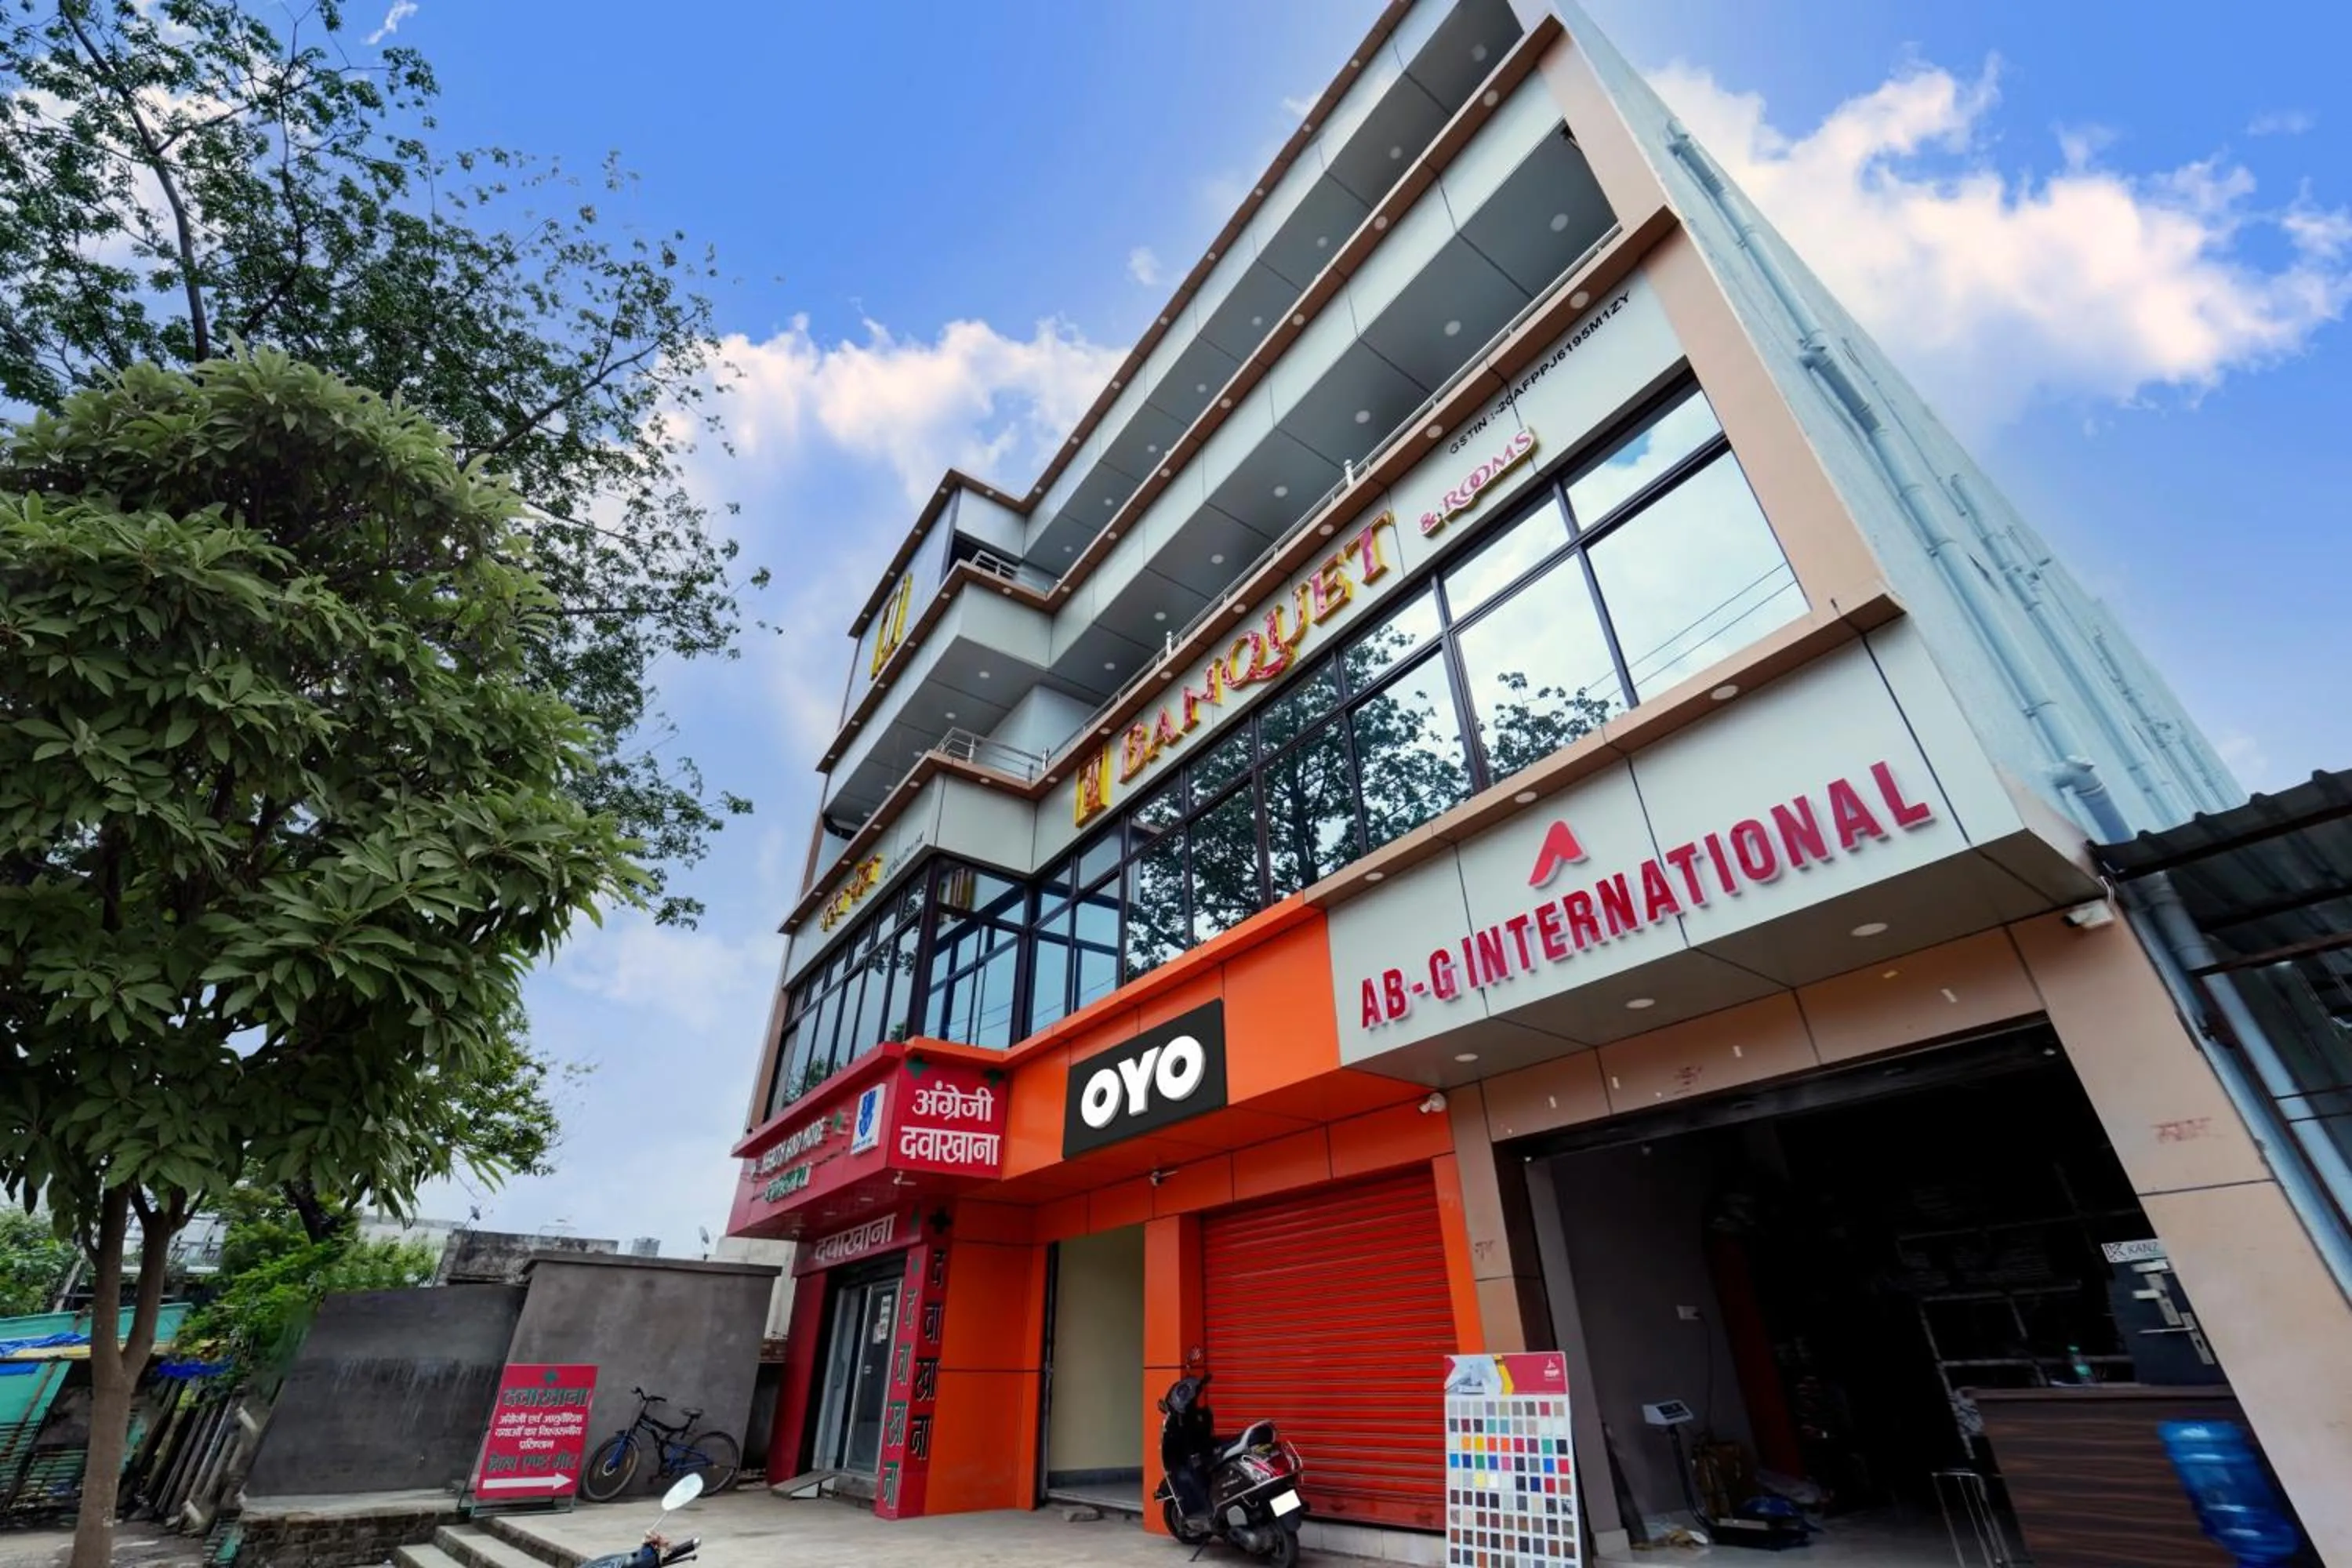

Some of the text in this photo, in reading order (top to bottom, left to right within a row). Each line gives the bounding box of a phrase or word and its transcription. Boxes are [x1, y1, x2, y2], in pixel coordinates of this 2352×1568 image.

[1450, 416, 1488, 455] GSTIN
[1443, 426, 1540, 522] ROOMS
[1119, 511, 1396, 784] BANQUET
[1461, 760, 1934, 989] INTERNATIONAL
[911, 1080, 994, 1123] अंग्रेजी
[1080, 1035, 1207, 1129] OYO
[899, 1126, 1001, 1167] दवाखाना
[814, 1213, 898, 1262] दवाखाना
